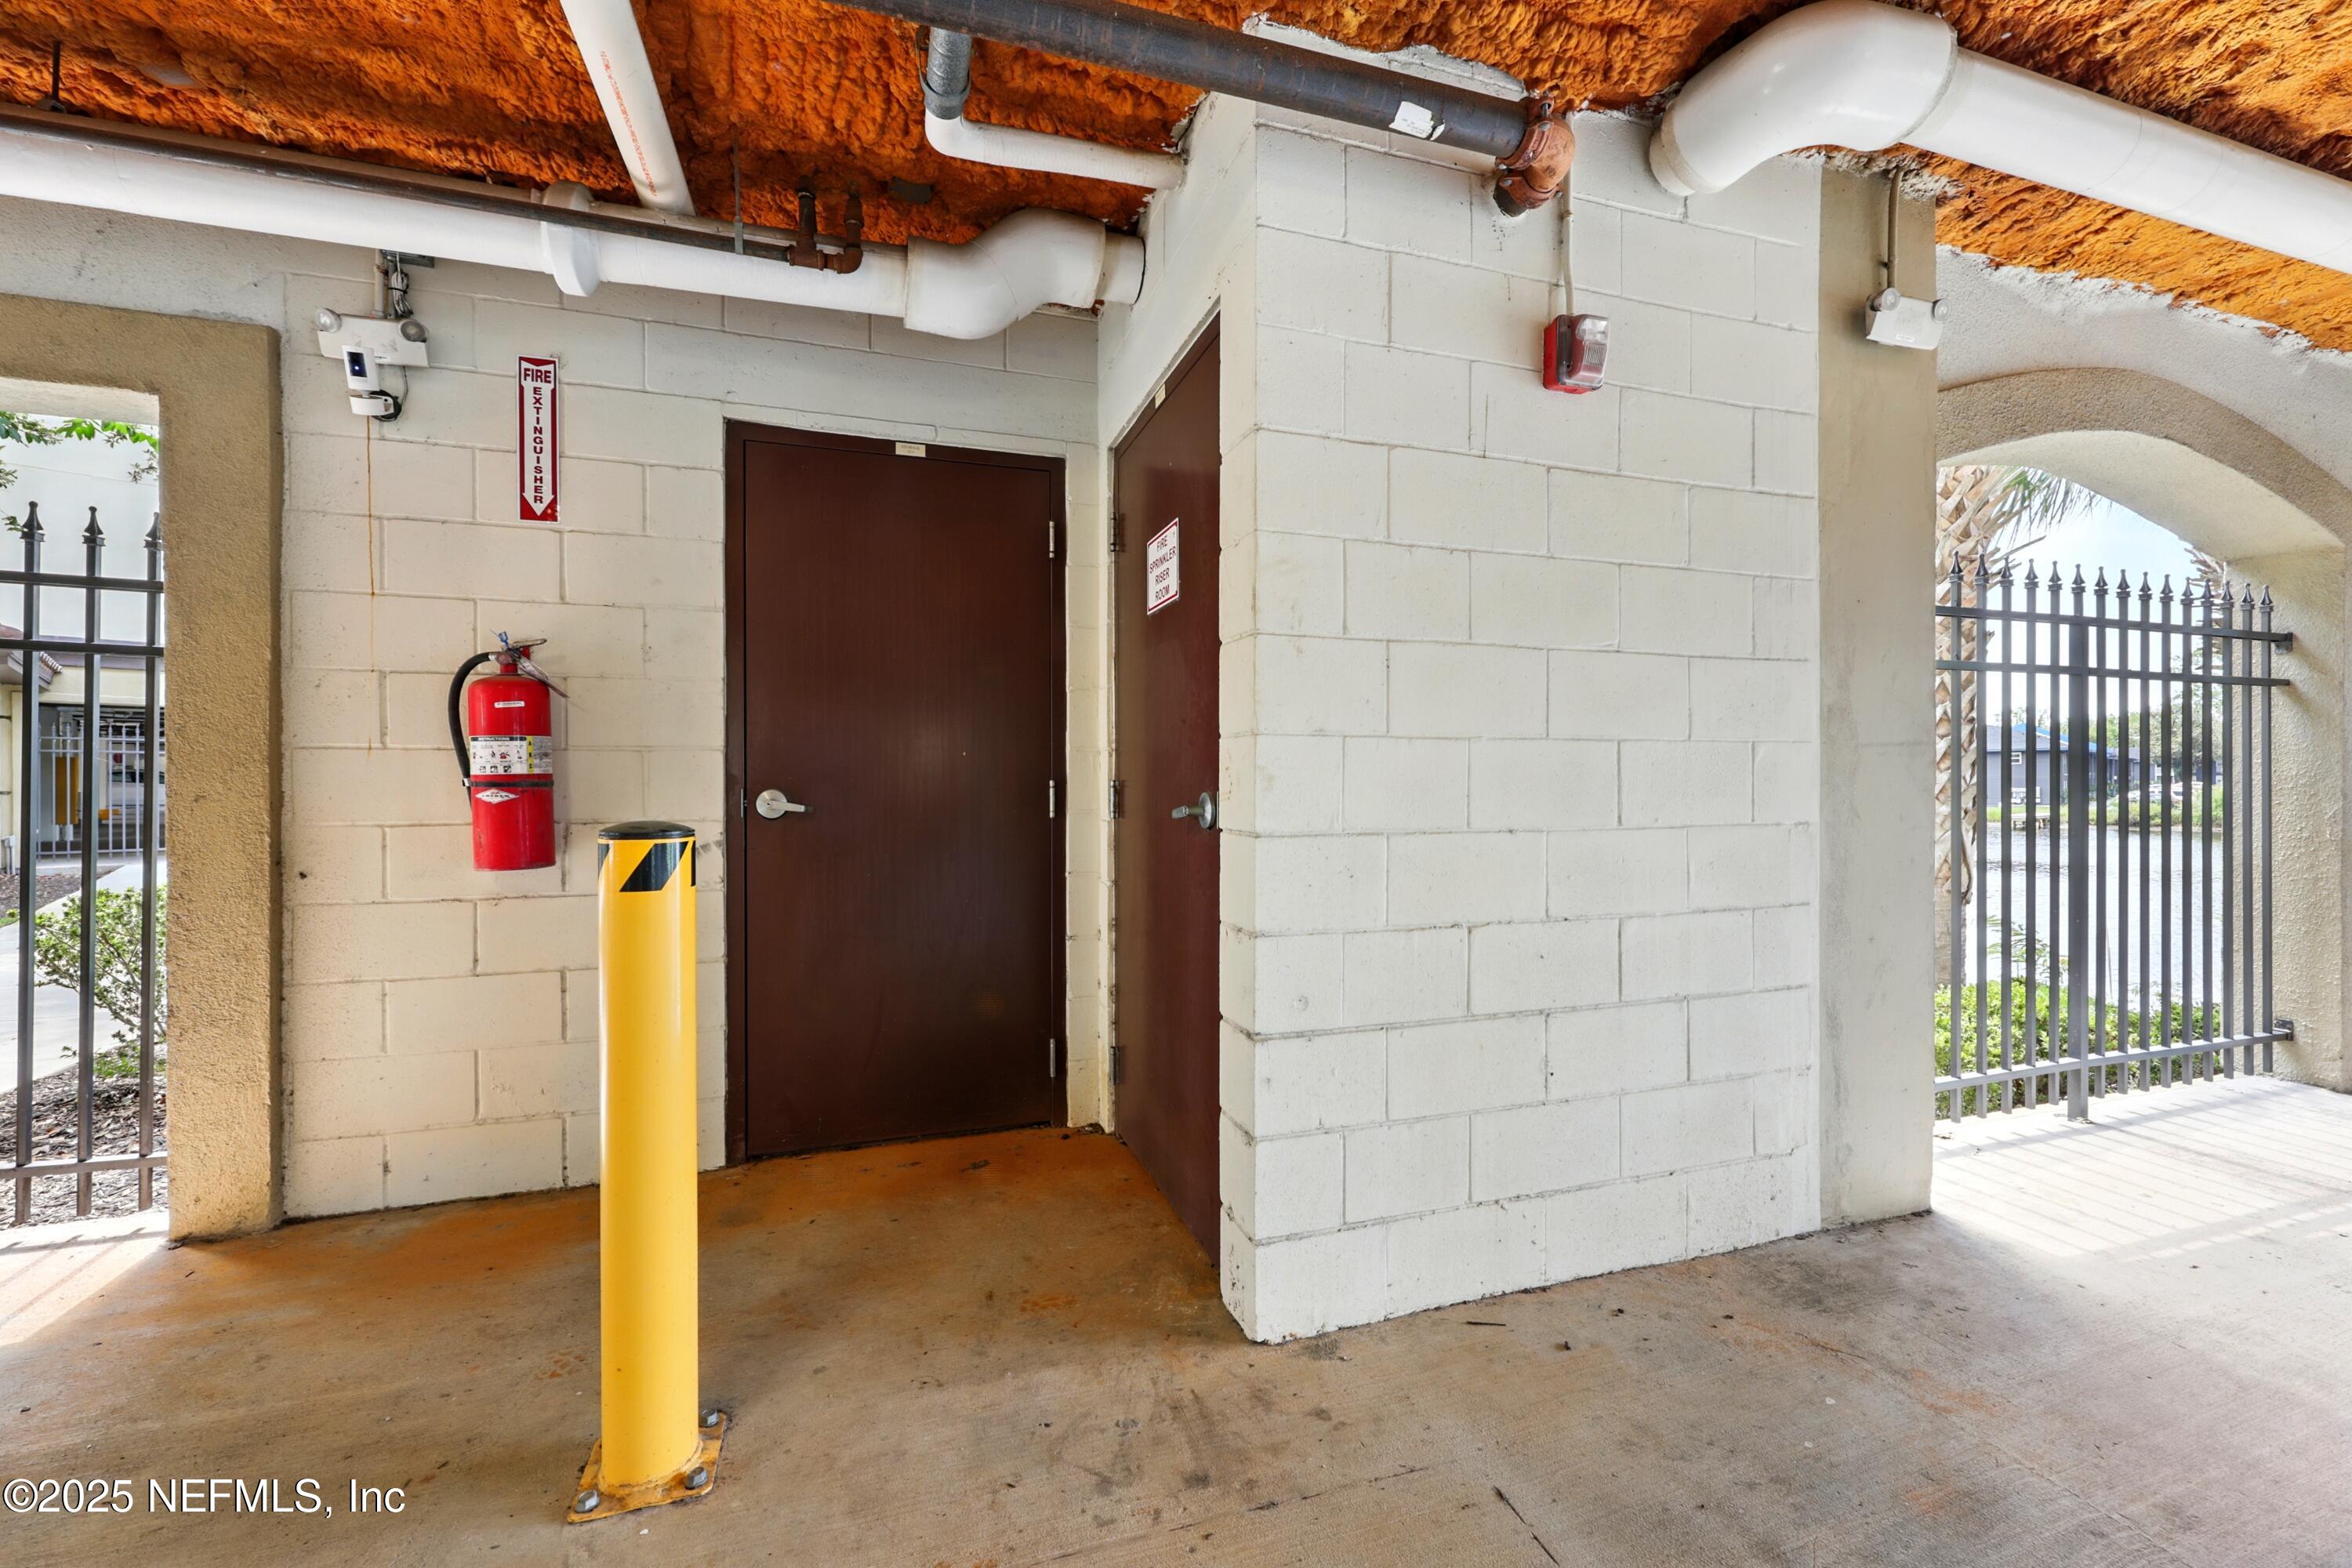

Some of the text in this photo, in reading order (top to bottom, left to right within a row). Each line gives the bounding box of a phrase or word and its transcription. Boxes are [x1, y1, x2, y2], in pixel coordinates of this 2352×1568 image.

[523, 368, 552, 383] FIRE
[532, 387, 543, 504] EXTINGUISHER
[1156, 535, 1167, 552] FIRE
[1149, 546, 1176, 574] SPRINKLER
[1155, 568, 1170, 586] RISER
[1155, 584, 1170, 602] ROOM
